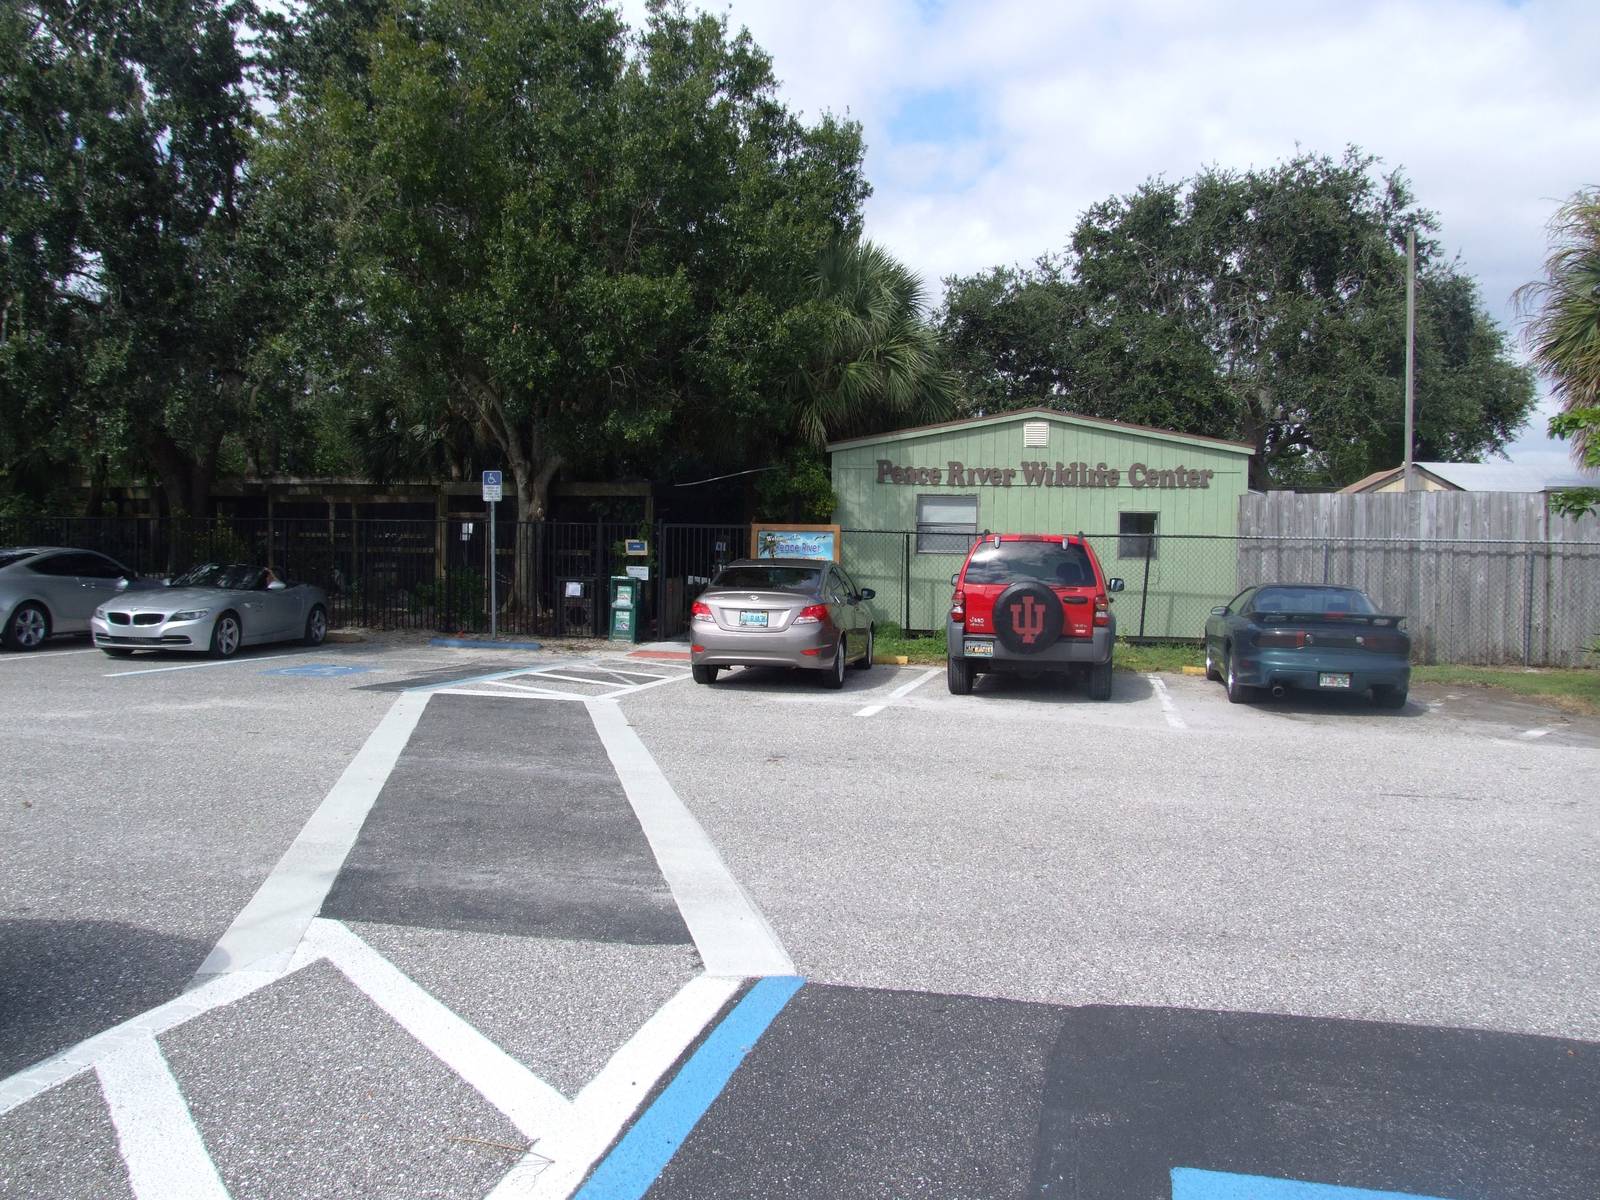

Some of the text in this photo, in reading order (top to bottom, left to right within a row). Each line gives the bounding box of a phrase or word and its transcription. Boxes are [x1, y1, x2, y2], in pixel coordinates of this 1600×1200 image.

[876, 459, 1214, 490] Peace River Wildlife Center
